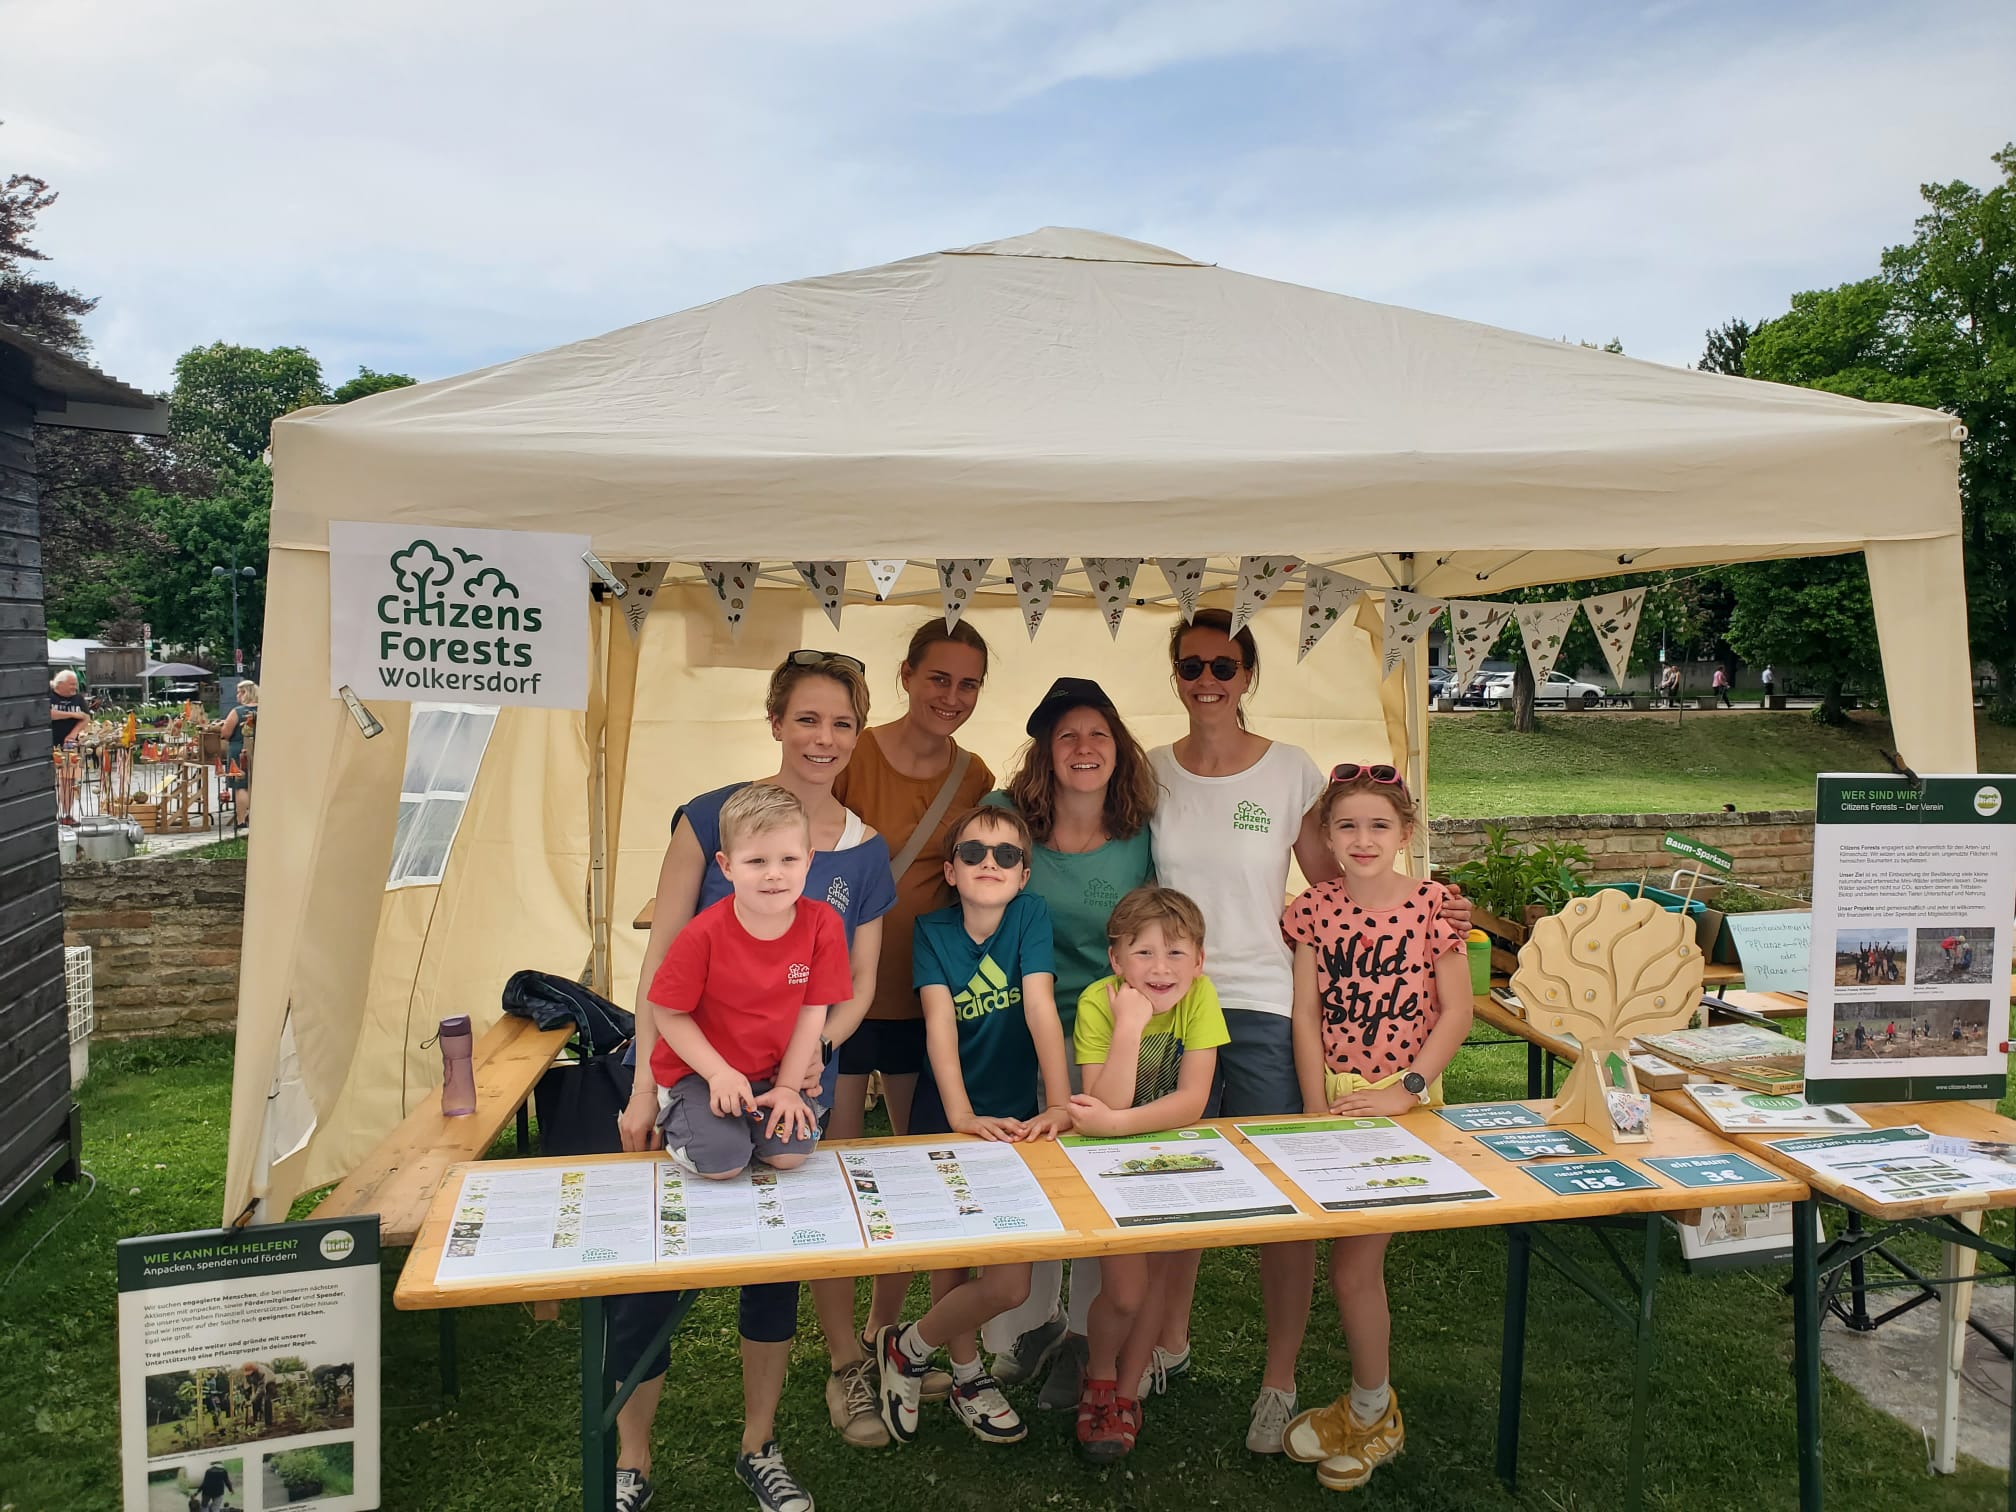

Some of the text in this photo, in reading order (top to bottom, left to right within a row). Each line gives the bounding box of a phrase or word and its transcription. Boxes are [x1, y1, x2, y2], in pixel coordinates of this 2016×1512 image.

[378, 591, 542, 632] Citizens
[380, 631, 532, 667] Forests
[378, 667, 542, 694] Wolkersdorf
[1841, 790, 1924, 800] WER SIND WIR?
[1841, 802, 1870, 811] Citizens
[1870, 802, 1898, 811] Forests
[1906, 803, 1919, 811] Der
[1920, 802, 1944, 811] Verein
[1234, 812, 1270, 824] Citizens
[1234, 822, 1268, 833] Forests
[1323, 931, 1409, 984] Wild
[1320, 978, 1422, 1046] Style
[1465, 1116, 1532, 1128] 150€
[1516, 1144, 1576, 1156] 50€
[1670, 1158, 1731, 1169] ein Baum
[1702, 1169, 1744, 1182] 3€
[1570, 1176, 1625, 1190] 15€
[144, 1240, 298, 1265] WIE KANN ICH HELFEN?
[144, 1251, 297, 1276] Anpacken, spenden und fördern
[183, 1296, 221, 1306] engagierte
[244, 1296, 301, 1306] Fördermitglieder
[258, 1312, 296, 1322] geeigneten
[243, 1337, 266, 1346] gründe
[145, 1356, 196, 1366] Unterstützung
[214, 1346, 260, 1357] Pflanzgruppe
